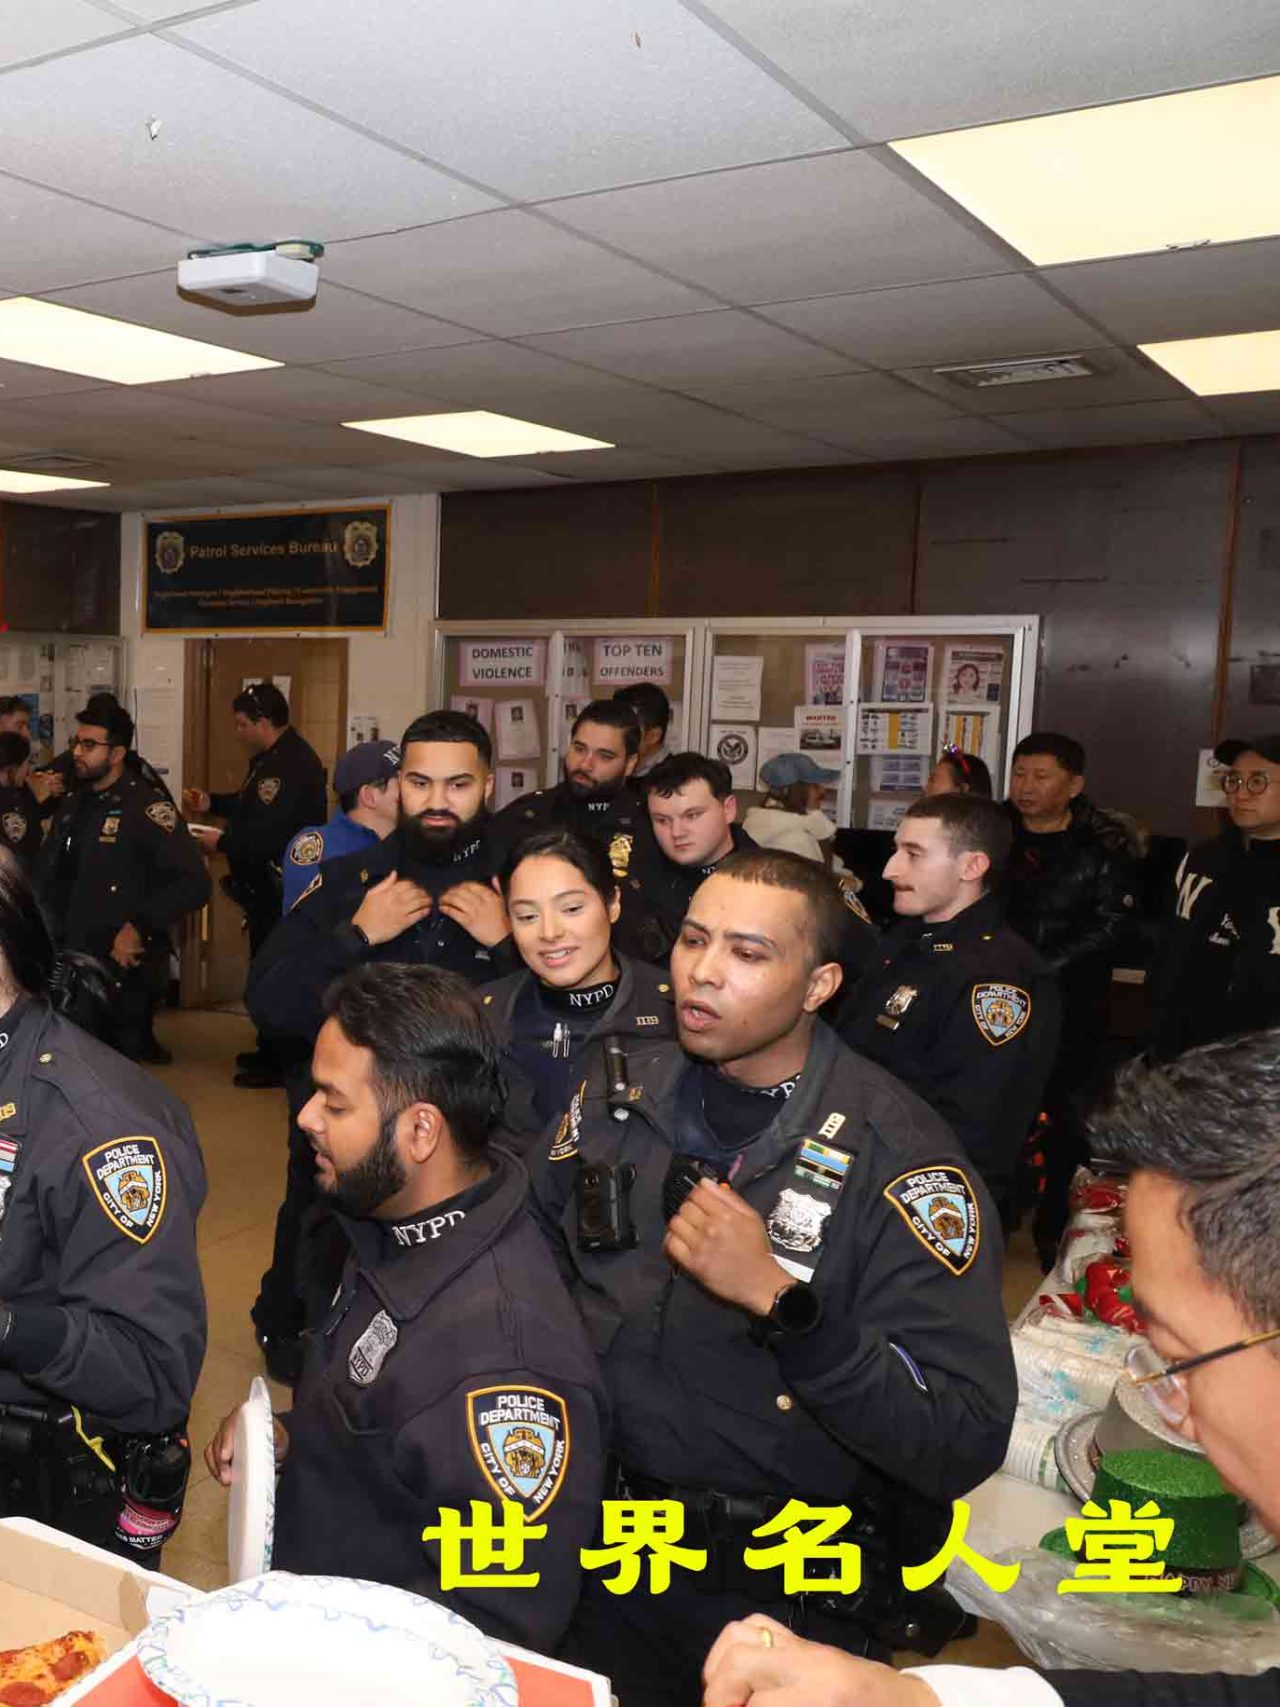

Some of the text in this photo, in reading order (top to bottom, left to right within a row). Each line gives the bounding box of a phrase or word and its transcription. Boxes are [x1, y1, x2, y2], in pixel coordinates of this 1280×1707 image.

[190, 540, 338, 559] Patrol Services Bureau
[472, 646, 533, 659] DOMESTIC
[603, 644, 663, 657] TOP TEN
[473, 666, 532, 680] VIOLENCE
[600, 666, 664, 678] OFFENDERS
[568, 984, 614, 1008] NYPD
[104, 1144, 140, 1163] POLICE
[96, 1154, 155, 1181] DEPARTMENT
[906, 1171, 950, 1188] POLICE
[146, 1170, 162, 1228] NEW YORK
[899, 1181, 967, 1204] DEPARTMENT
[102, 1192, 134, 1228] CITY OF
[391, 1210, 466, 1247] NYPD
[912, 1215, 951, 1257] CITY OF
[964, 1234, 975, 1259] NEW
[497, 1395, 545, 1411] POLICE
[480, 1408, 561, 1431] DEPARTMENT
[480, 1442, 516, 1496] CITY OF
[533, 1439, 565, 1504] NEW YORK
